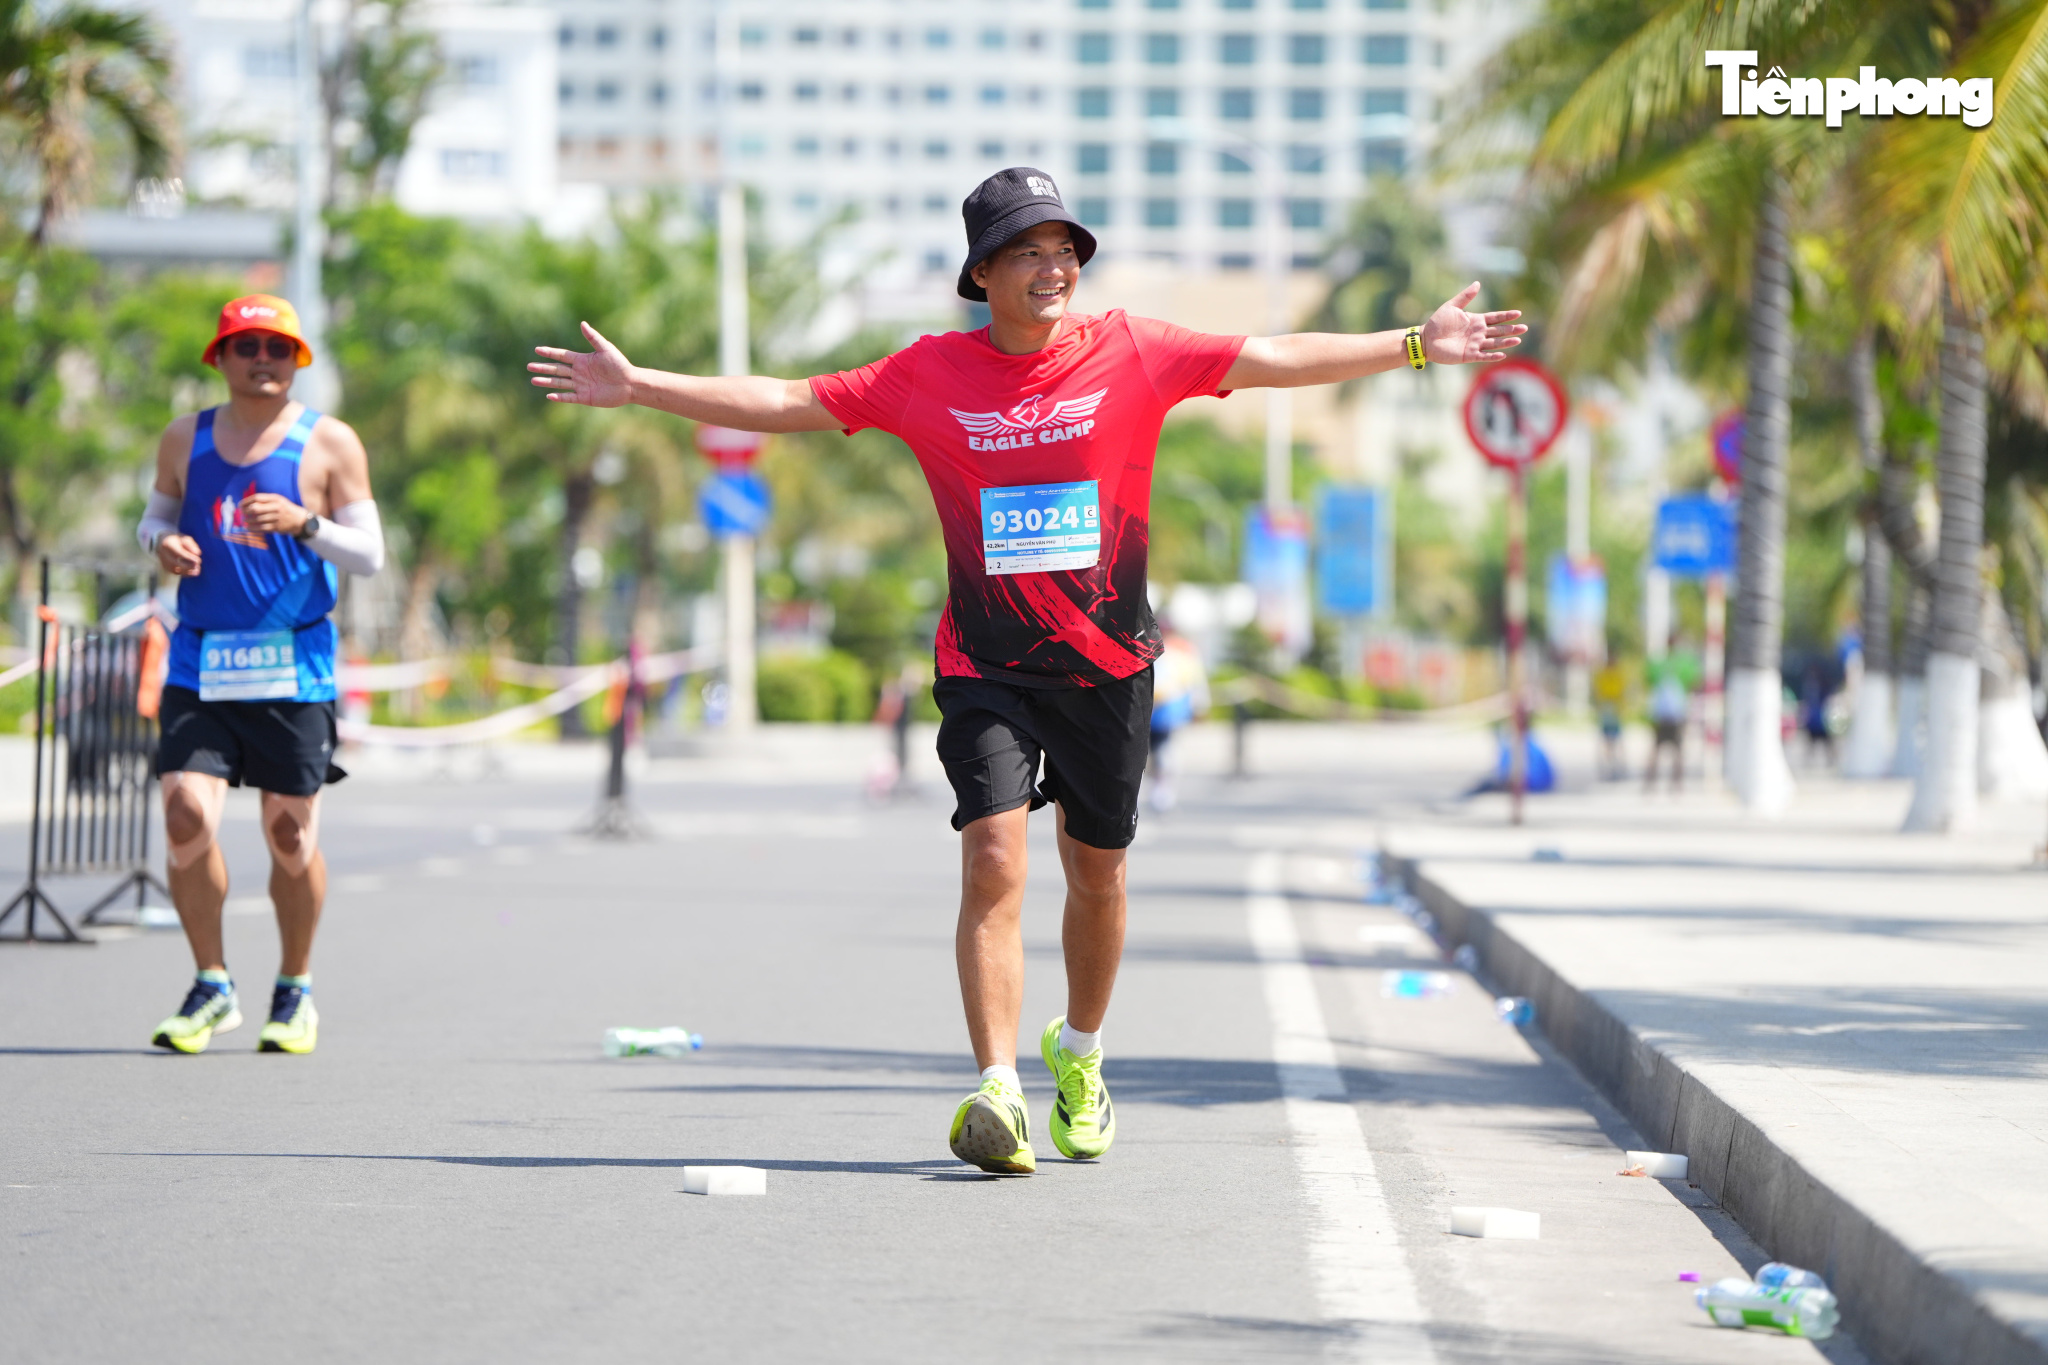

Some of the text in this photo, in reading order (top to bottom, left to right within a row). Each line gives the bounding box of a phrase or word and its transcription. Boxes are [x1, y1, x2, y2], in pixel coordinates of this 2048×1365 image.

[968, 419, 1096, 452] EAGLE CAMP
[990, 506, 1080, 534] 93024
[996, 561, 1001, 569] 2
[206, 645, 278, 670] 91683
